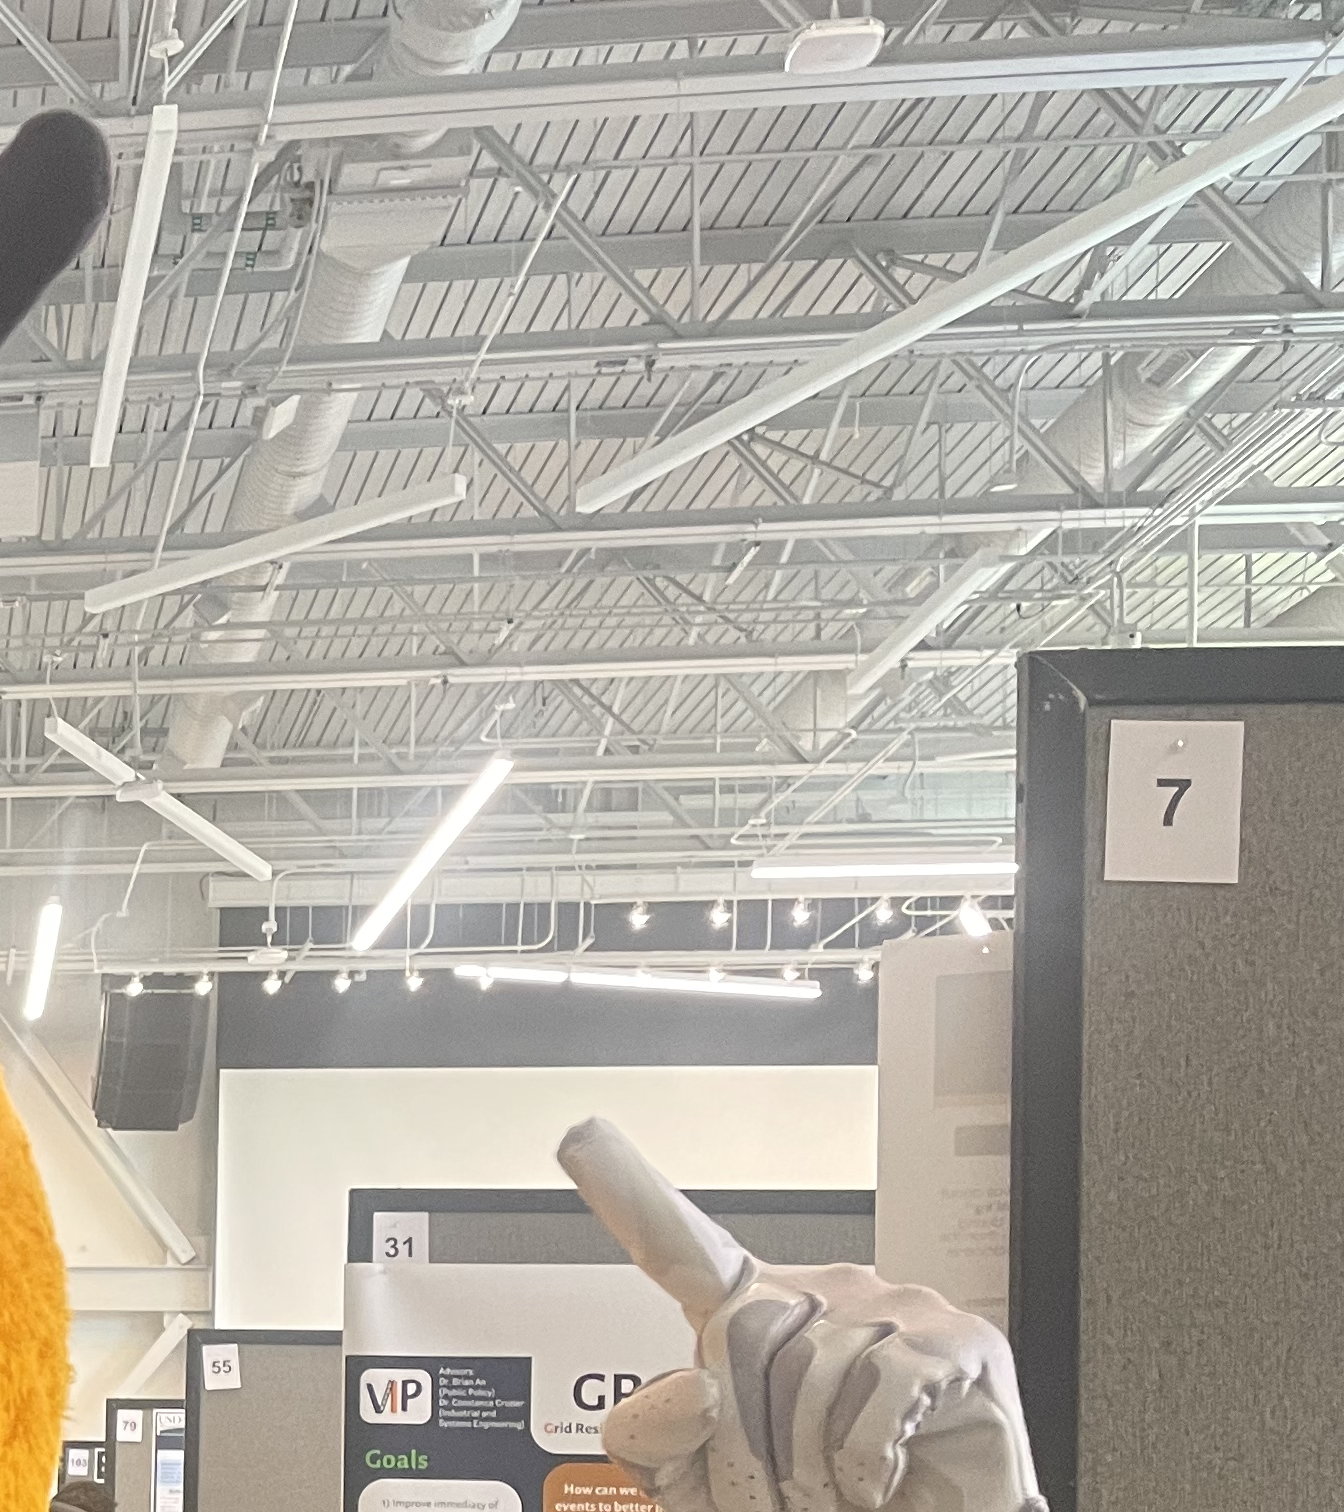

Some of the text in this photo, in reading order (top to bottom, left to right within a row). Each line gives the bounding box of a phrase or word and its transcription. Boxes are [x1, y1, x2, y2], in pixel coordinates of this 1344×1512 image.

[1156, 778, 1192, 827] 7
[385, 1237, 414, 1258] 31
[211, 1360, 232, 1374] 55
[365, 1379, 423, 1415] VIP
[544, 1422, 572, 1434] Grid
[365, 1449, 428, 1470] Goals
[564, 1484, 593, 1495] How
[595, 1486, 616, 1496] can
[619, 1487, 637, 1496] we
[393, 1500, 431, 1508] Improve
[488, 1499, 499, 1509] of
[555, 1502, 596, 1512] events
[598, 1502, 611, 1512] to
[614, 1501, 653, 1512] better
